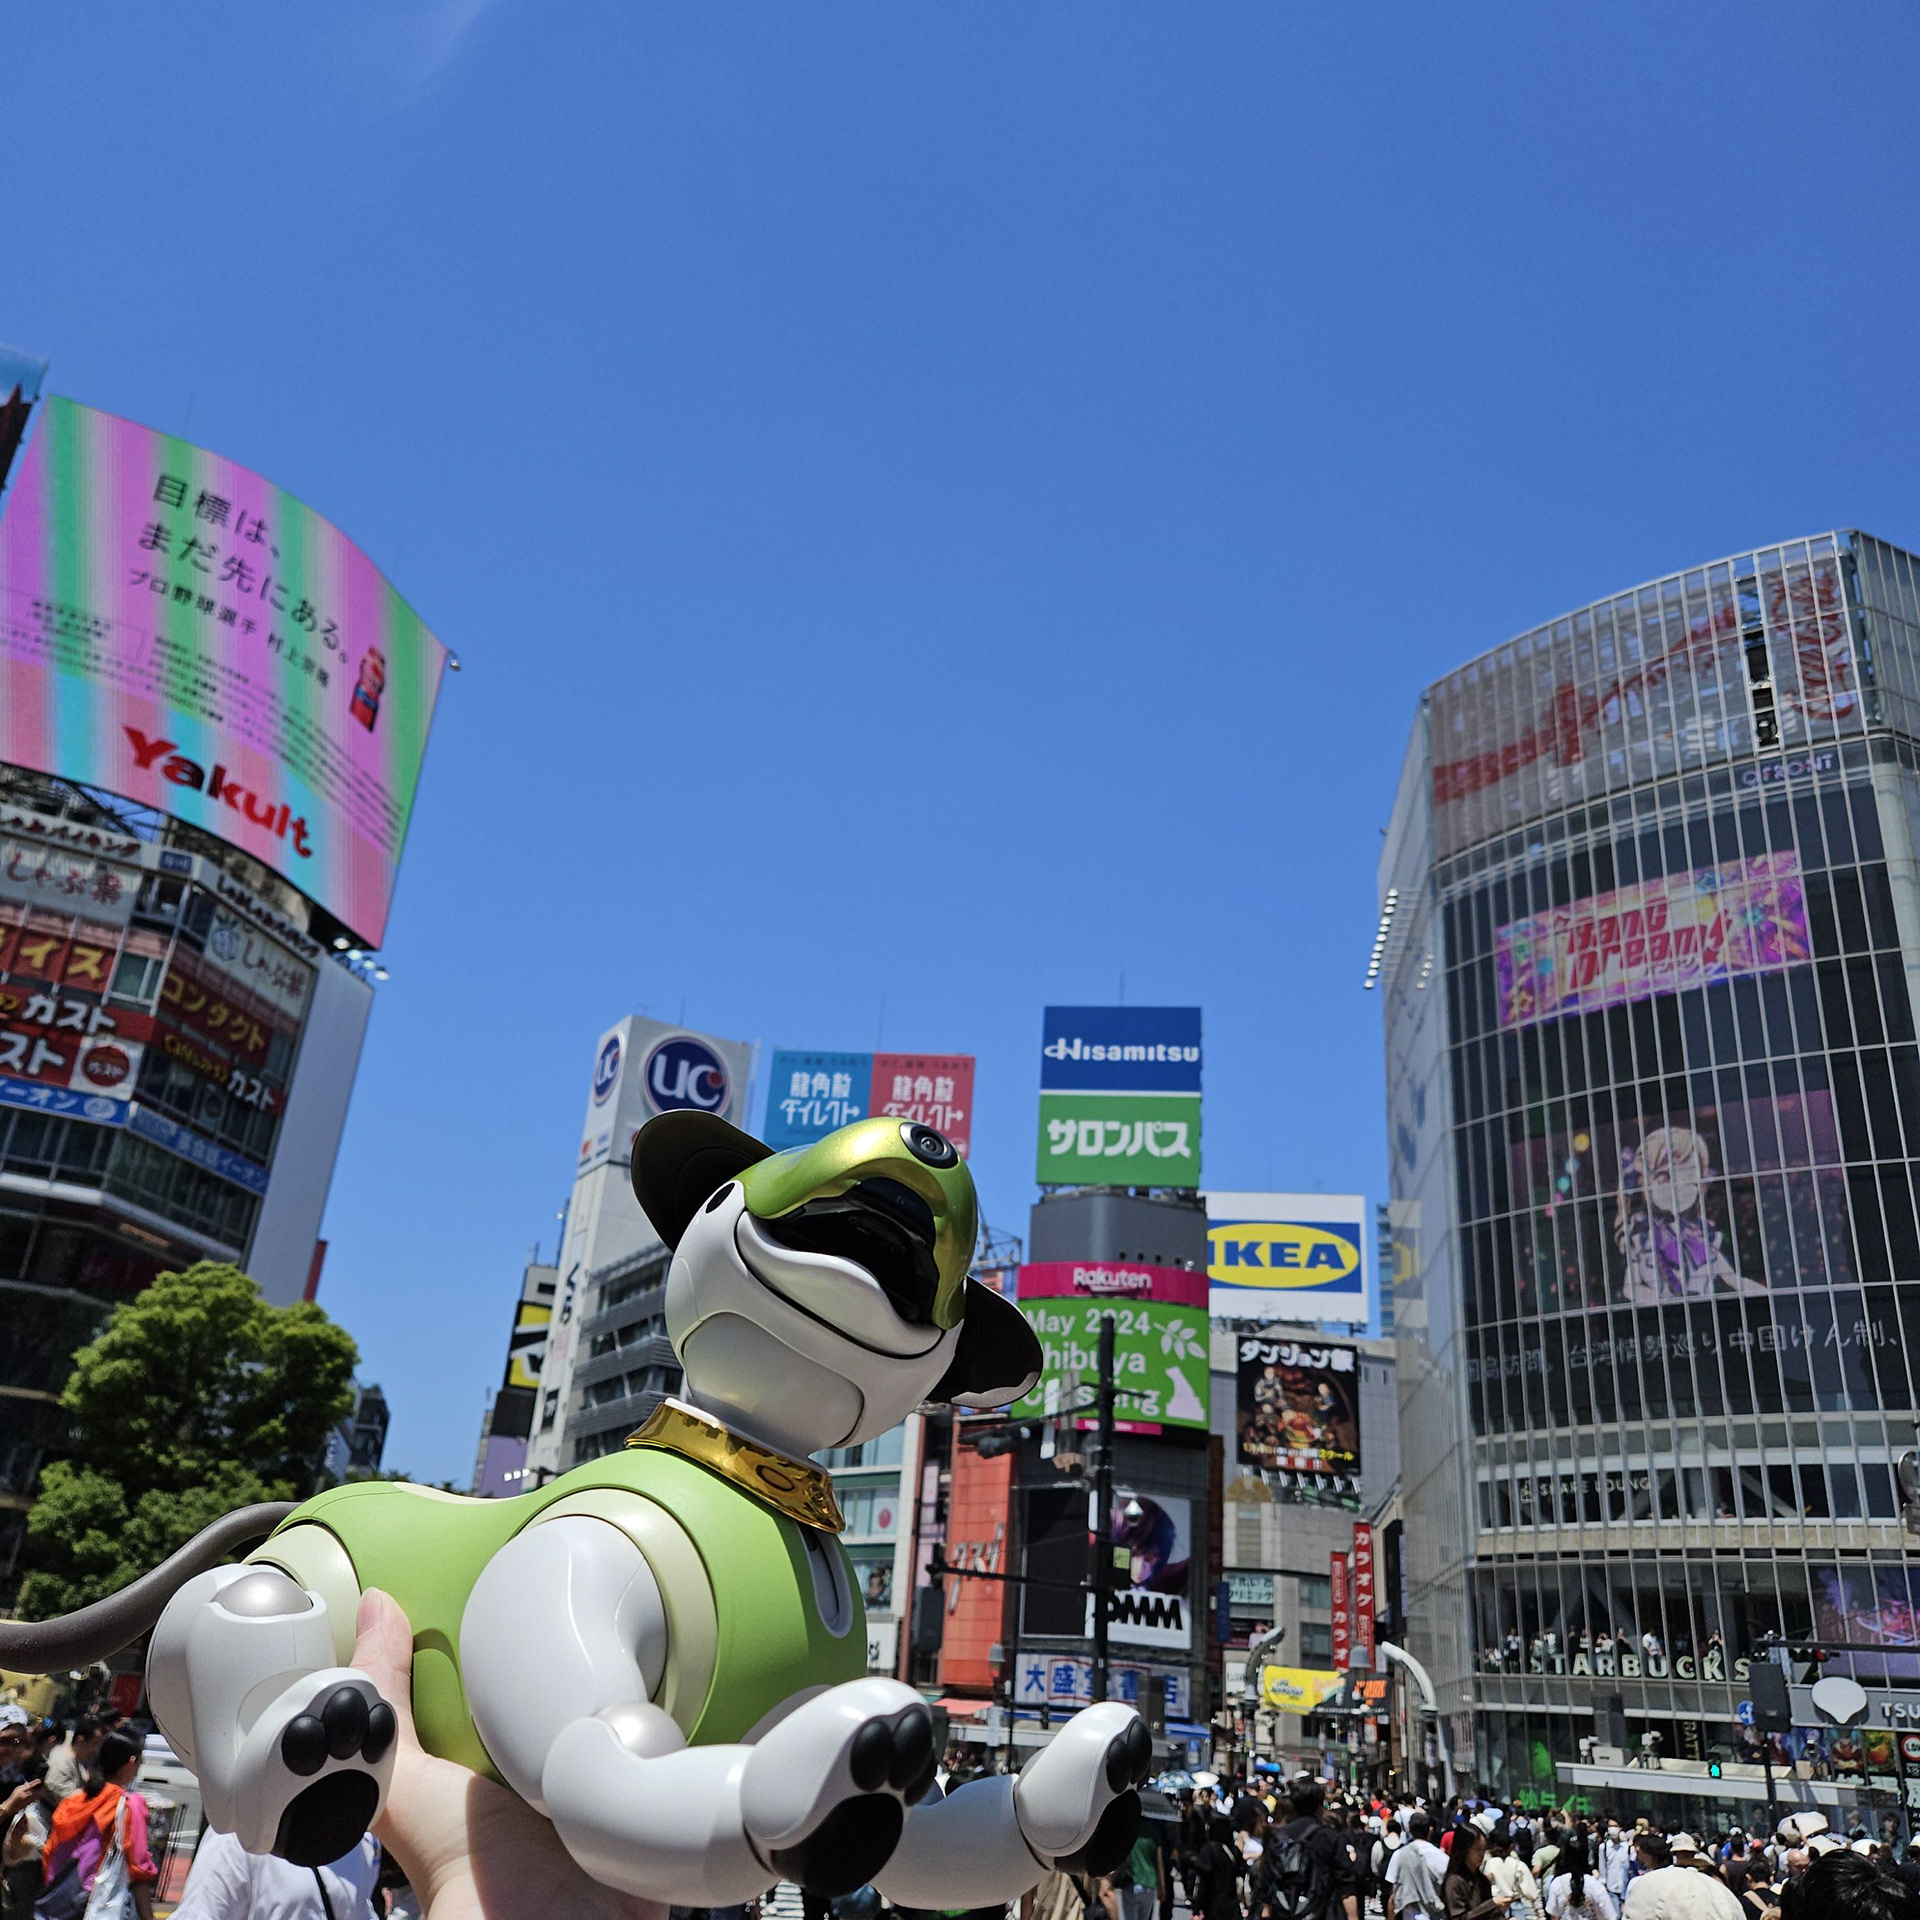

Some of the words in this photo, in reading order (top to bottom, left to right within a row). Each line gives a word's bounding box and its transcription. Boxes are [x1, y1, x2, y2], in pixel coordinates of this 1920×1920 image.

[154, 473, 280, 558] 目標は、
[128, 568, 258, 636] プロ野球選手
[138, 521, 349, 664] まだ先にある。
[122, 724, 313, 858] Yakult
[0, 926, 105, 980] イス
[22, 993, 117, 1036] ガスト
[162, 972, 266, 1053] コンタクト
[1044, 1037, 1200, 1063] Hisamitsu
[227, 1068, 276, 1111] ガスト
[789, 1071, 852, 1099] 龍角散
[891, 1074, 955, 1103] 龍角散
[779, 1098, 860, 1127] ダイレクト
[1047, 1119, 1191, 1158] サロンパス
[1072, 1266, 1153, 1290] Rakuten
[1026, 1308, 1076, 1337] May
[1044, 1341, 1147, 1377] hibuya
[1240, 1339, 1355, 1373] ダンジョン飯
[1355, 1531, 1374, 1608] カラオケ
[1530, 1650, 1752, 1682] STARBUCKS
